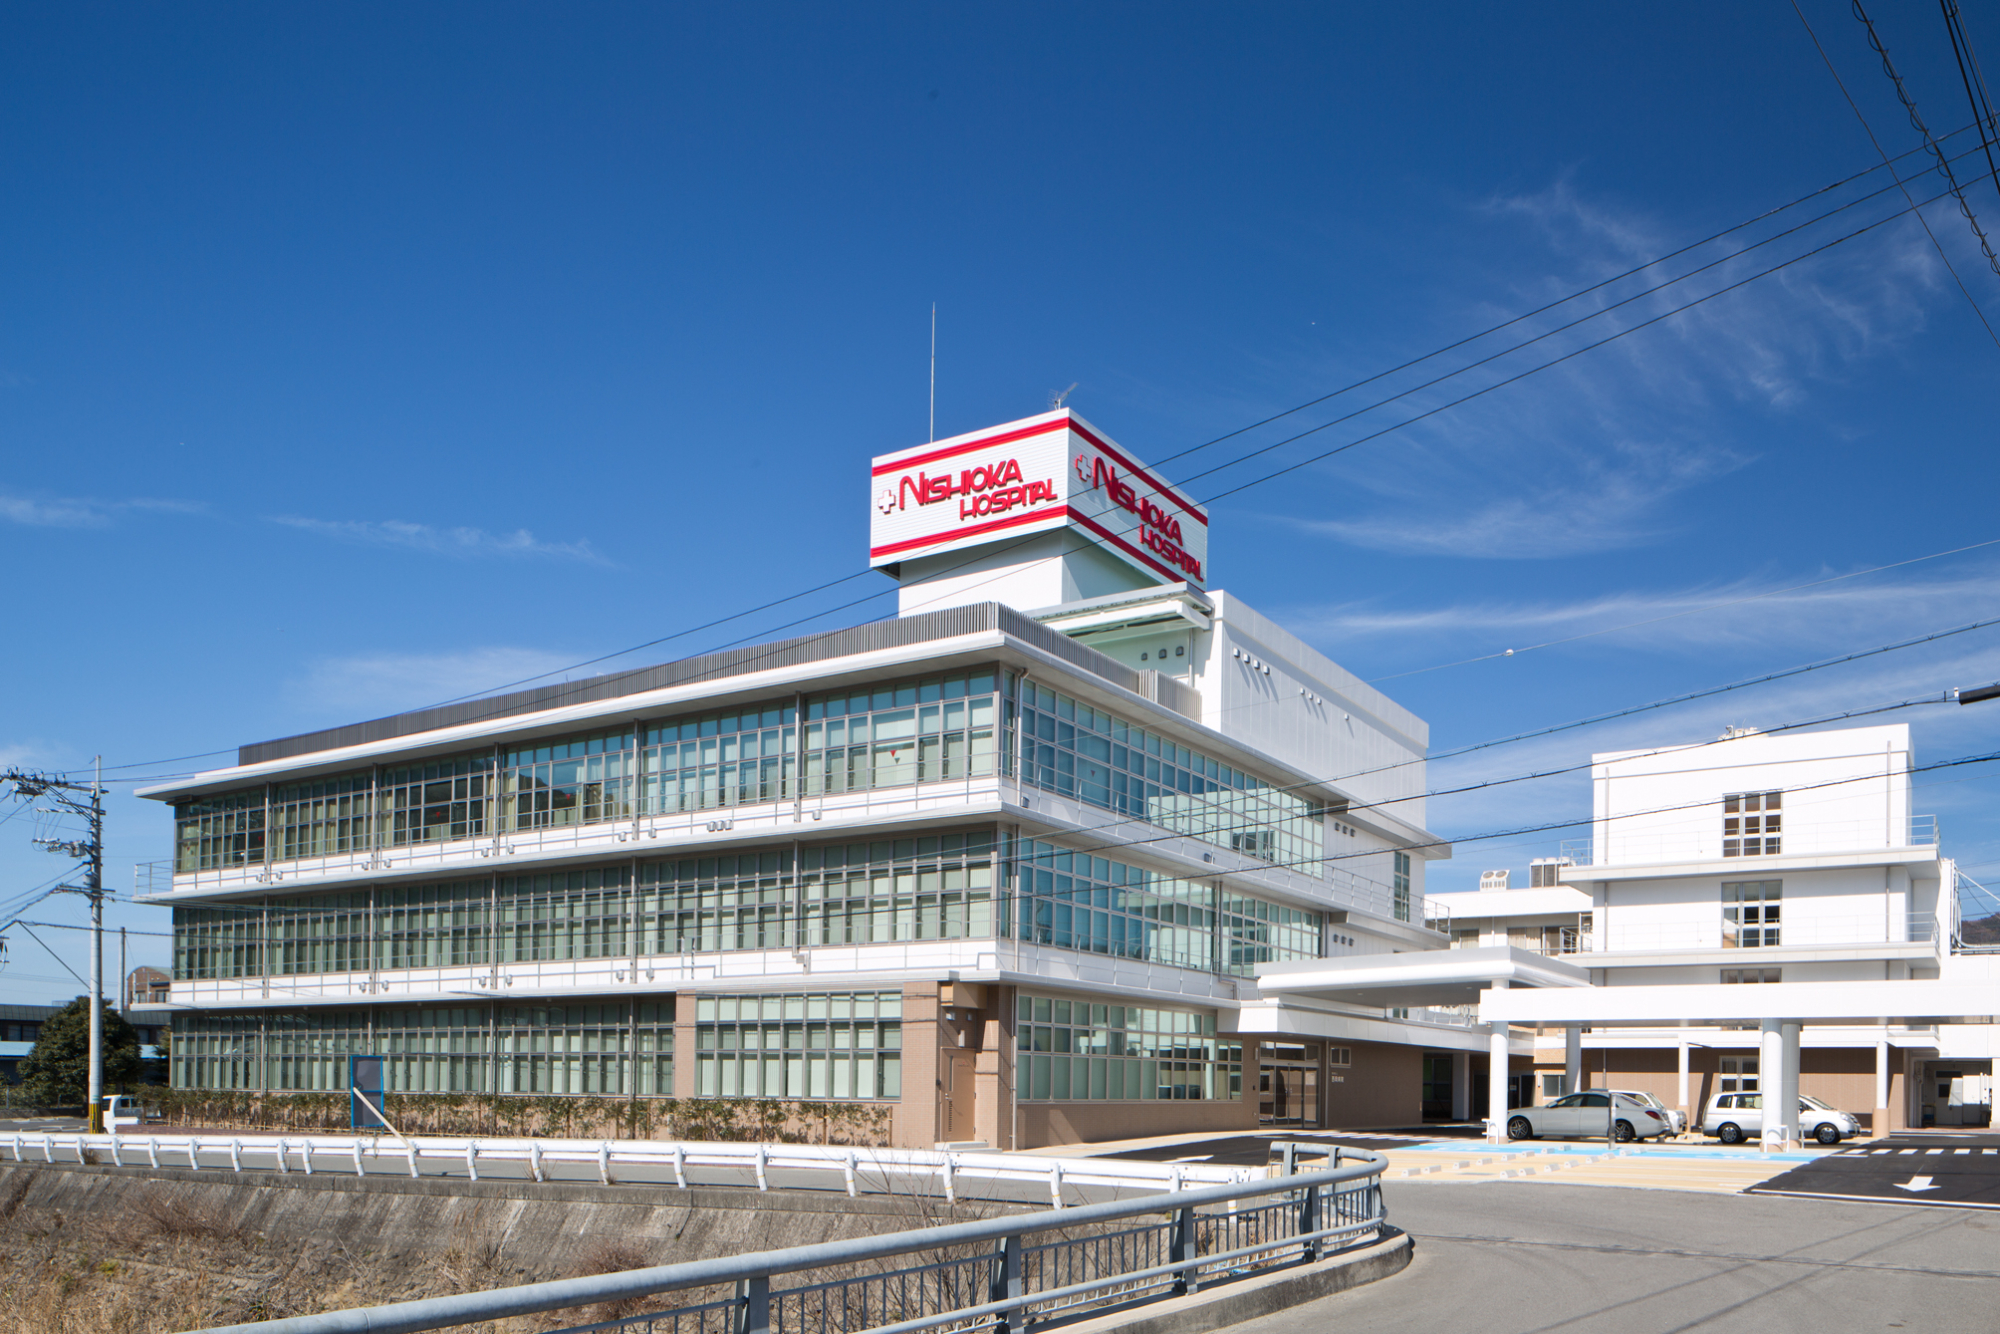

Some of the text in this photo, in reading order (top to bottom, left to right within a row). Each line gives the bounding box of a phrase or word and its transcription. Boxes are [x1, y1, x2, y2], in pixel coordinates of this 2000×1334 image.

[899, 458, 1023, 511] NISHIOKA
[959, 478, 1058, 521] HOSPITAL
[1093, 456, 1184, 547] NISHIOKA
[1139, 523, 1204, 582] HOSPITAL
